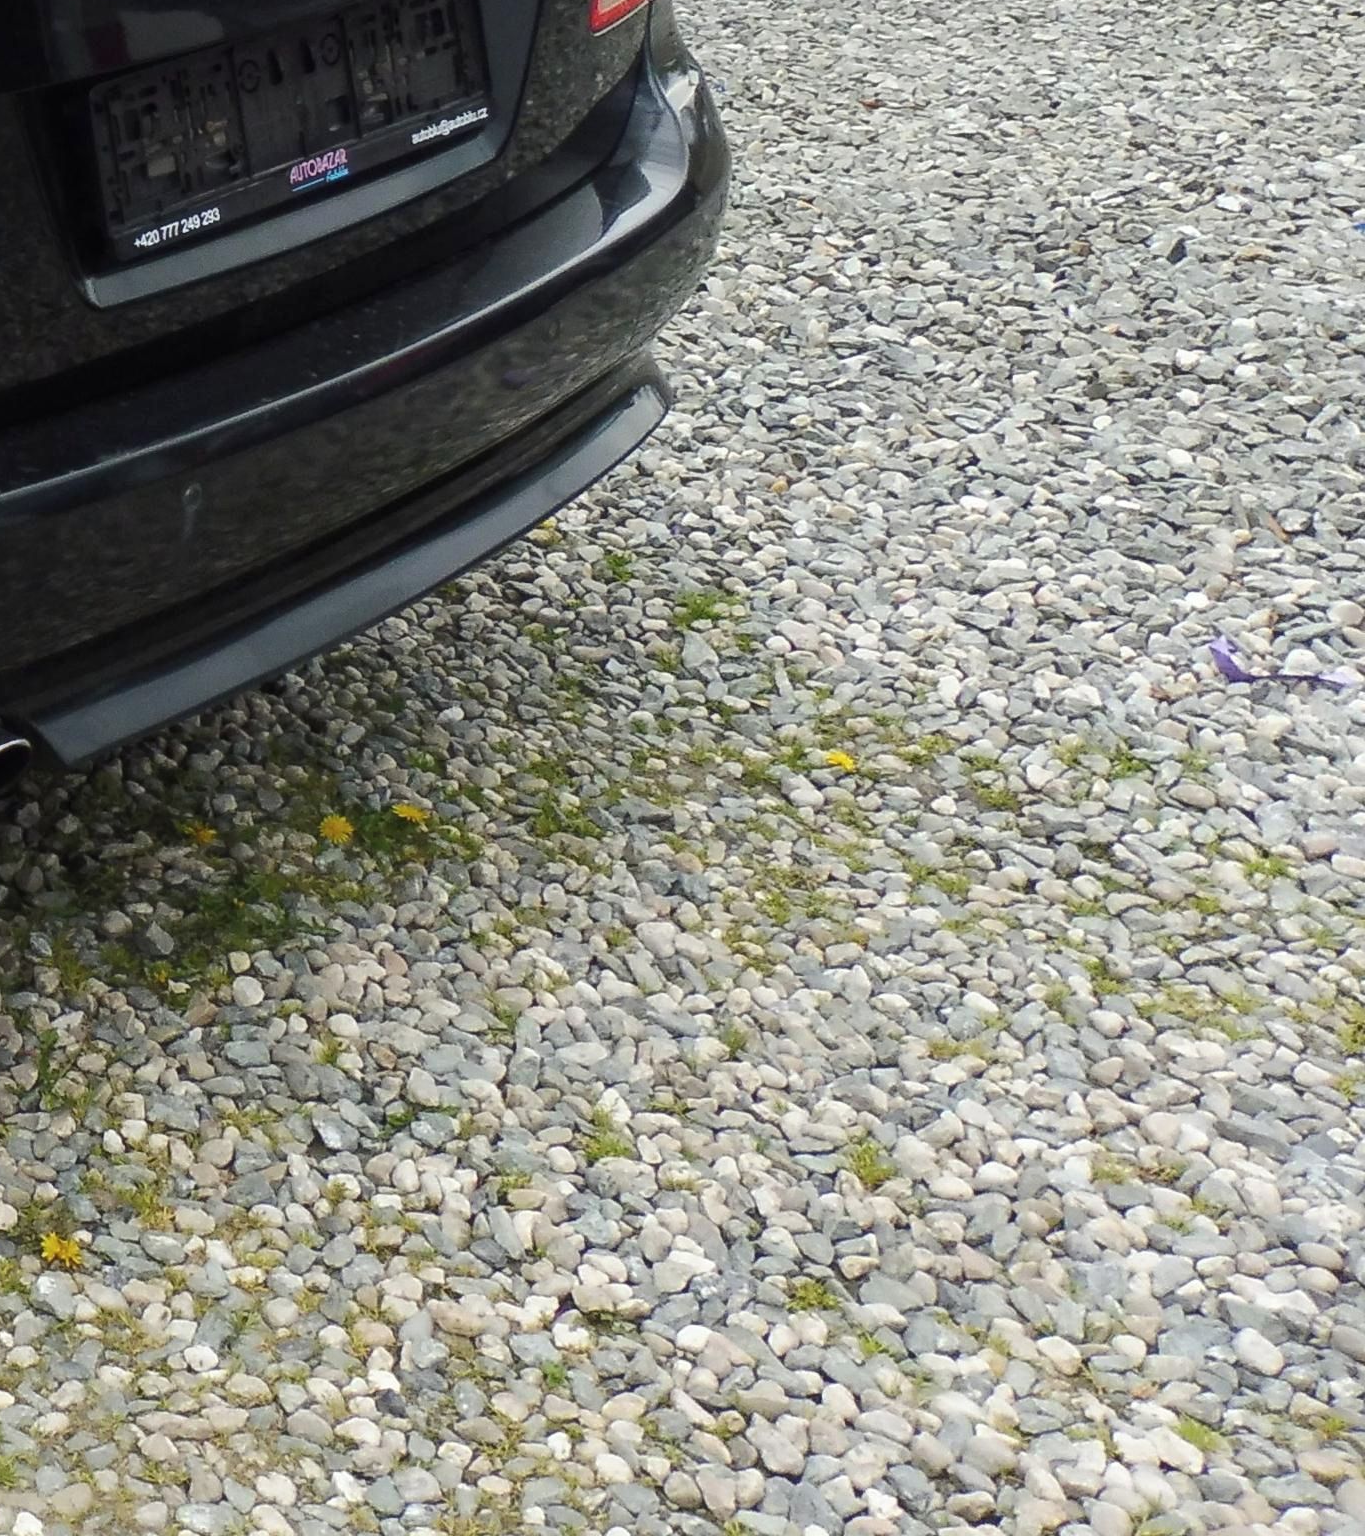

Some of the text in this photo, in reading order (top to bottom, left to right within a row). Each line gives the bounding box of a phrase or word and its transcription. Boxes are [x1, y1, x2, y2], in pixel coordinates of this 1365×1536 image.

[290, 148, 348, 184] AUTOBAZAR
[134, 207, 221, 248] +420 777 249 293
